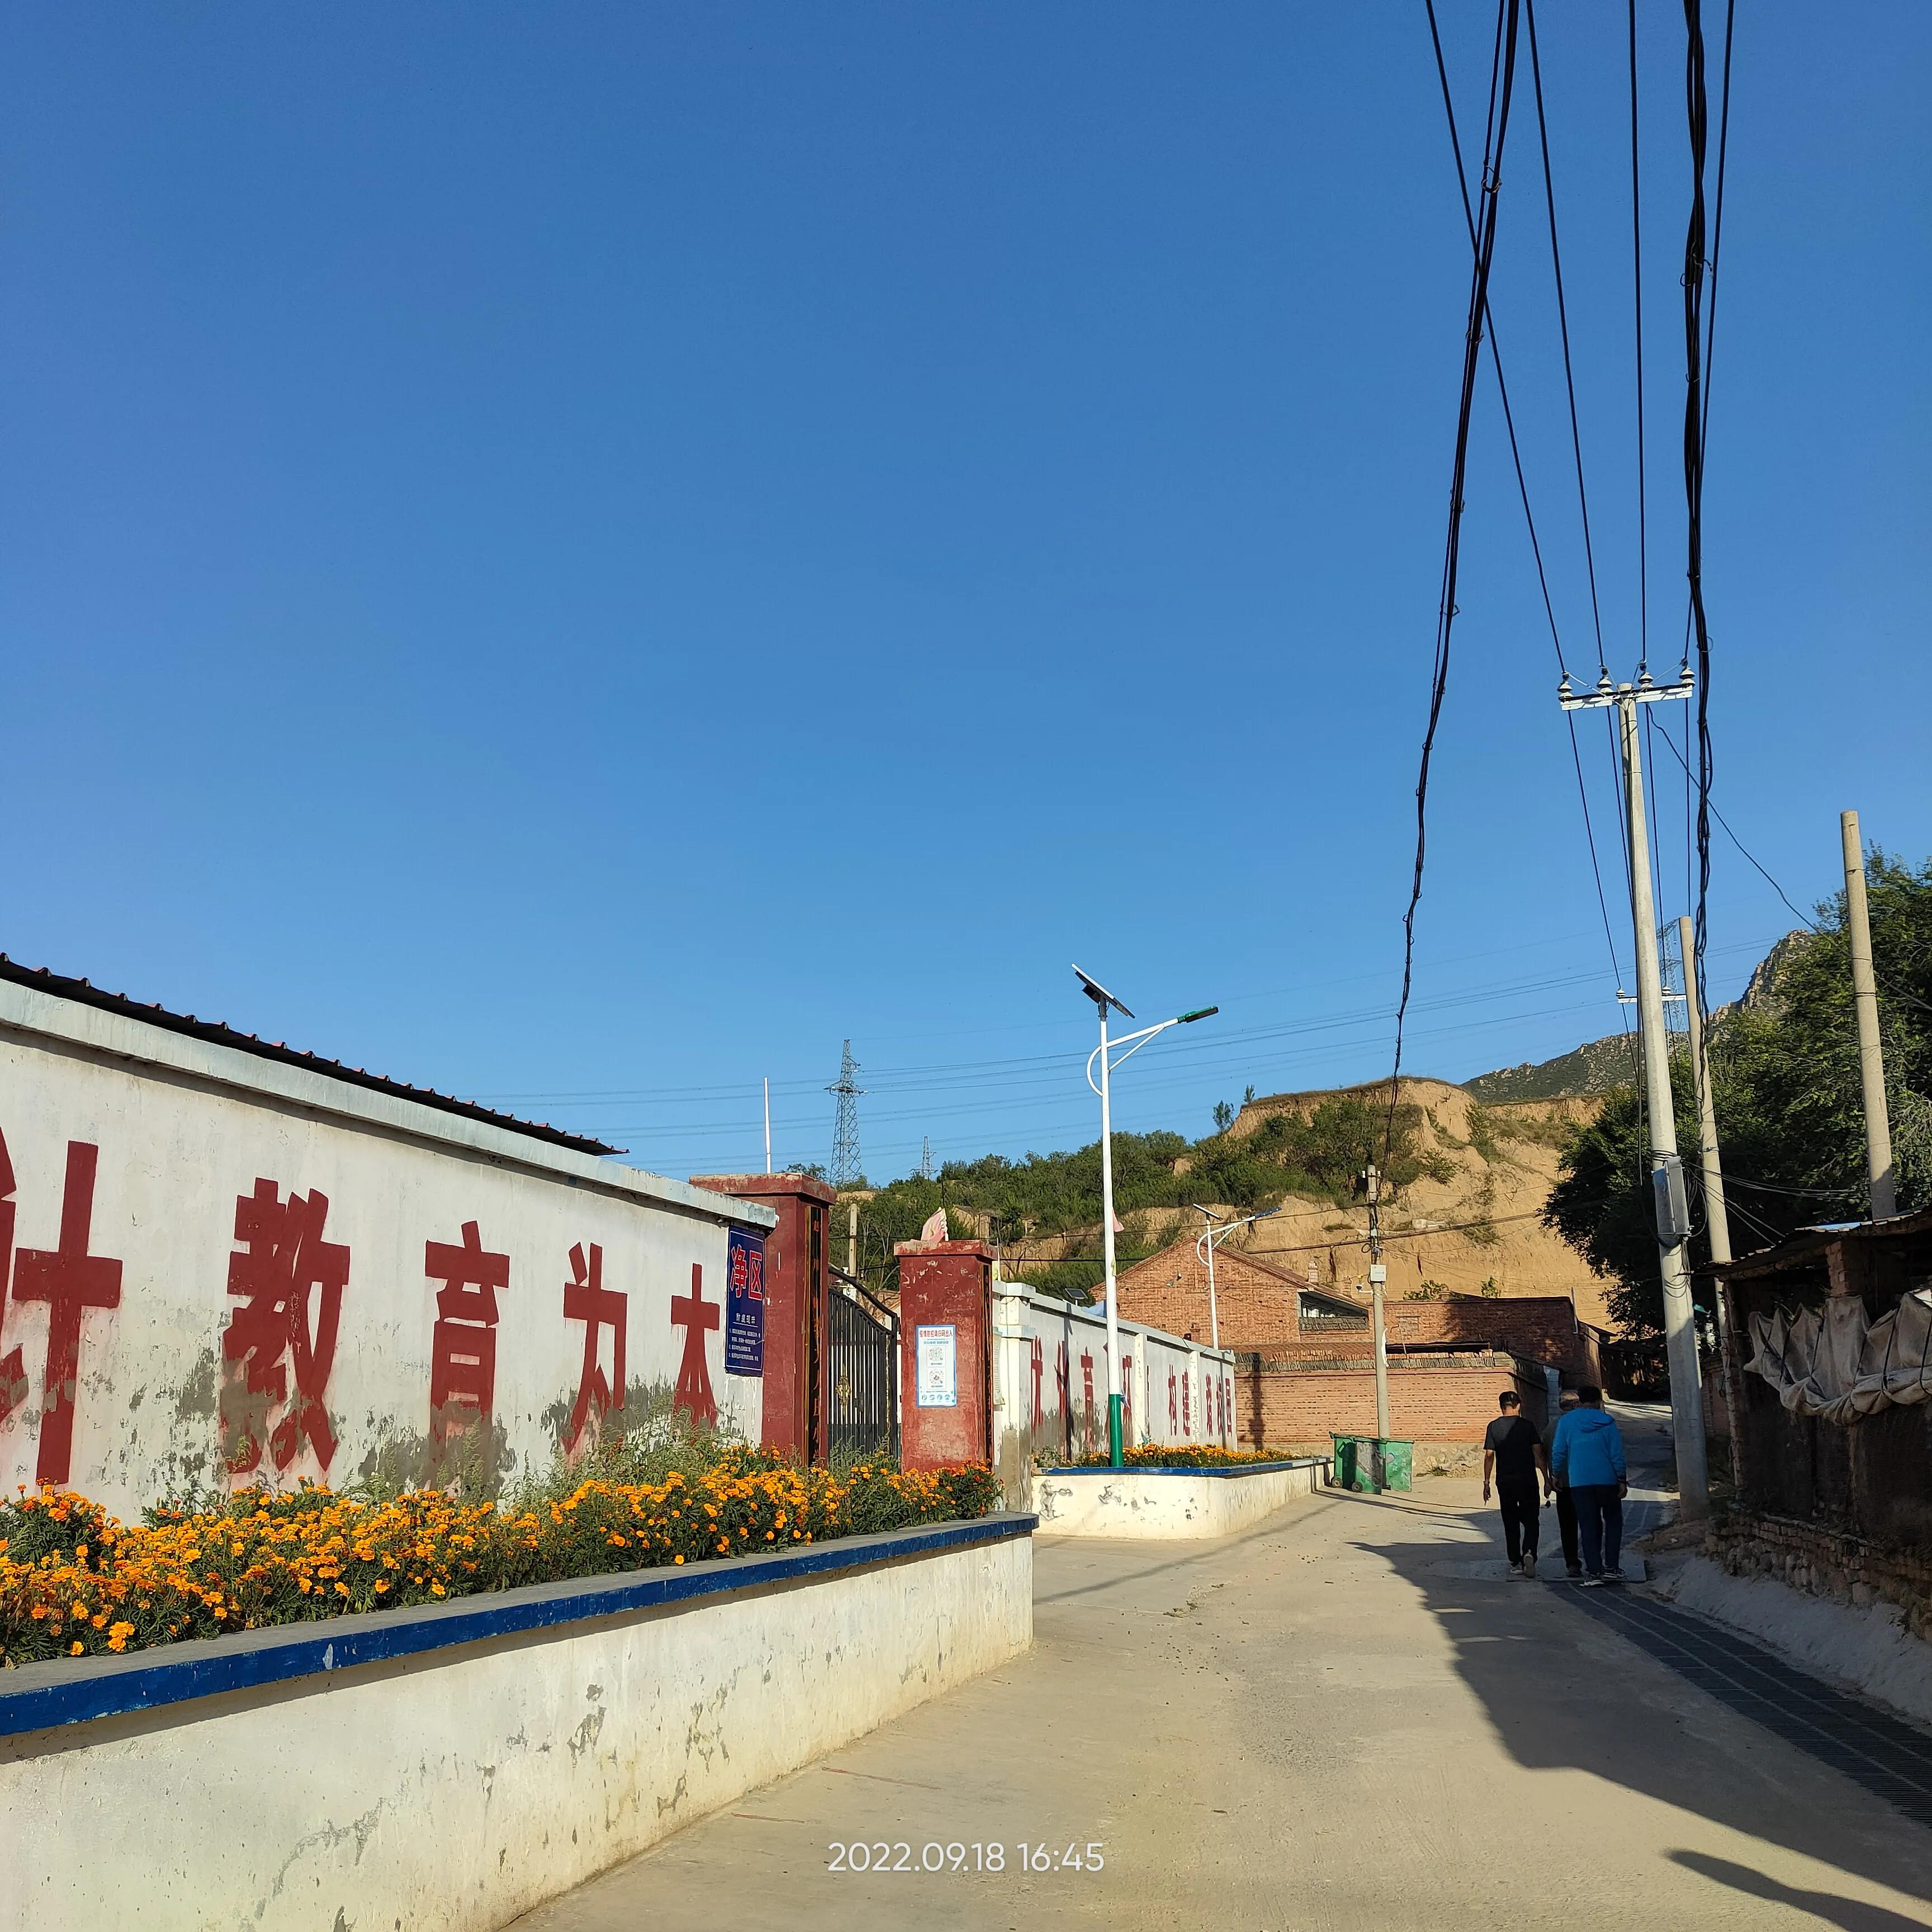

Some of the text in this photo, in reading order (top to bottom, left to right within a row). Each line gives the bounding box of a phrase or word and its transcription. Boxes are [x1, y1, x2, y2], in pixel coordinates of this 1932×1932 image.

[730, 1243, 763, 1301] 净区
[1168, 1364, 1233, 1437] 构建谐校园
